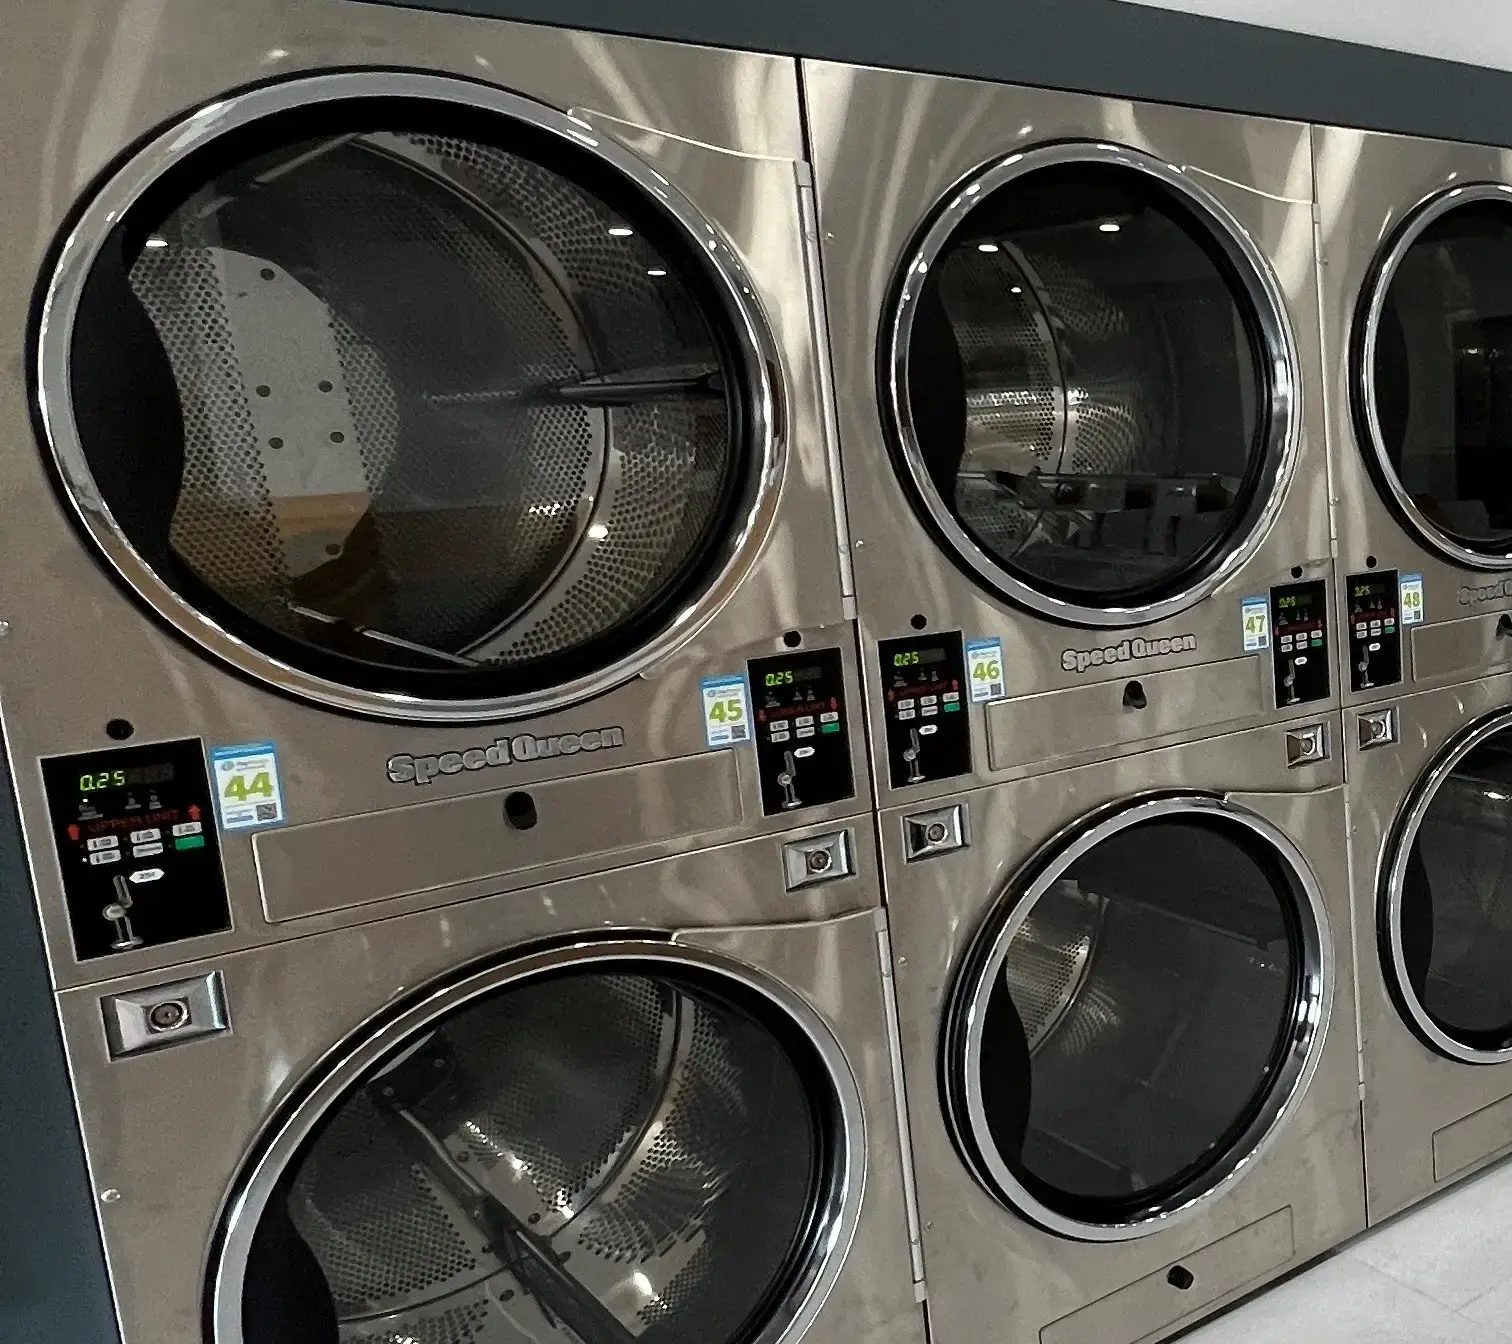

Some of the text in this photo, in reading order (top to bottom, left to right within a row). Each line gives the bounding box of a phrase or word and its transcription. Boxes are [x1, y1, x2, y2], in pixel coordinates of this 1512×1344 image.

[1404, 592, 1420, 608] 48
[1246, 615, 1265, 633] 47
[1061, 634, 1197, 673] Speed Queen
[973, 660, 1000, 681] 46
[709, 699, 744, 723] 45
[386, 726, 625, 785] Speed Queen
[224, 772, 273, 801] 44
